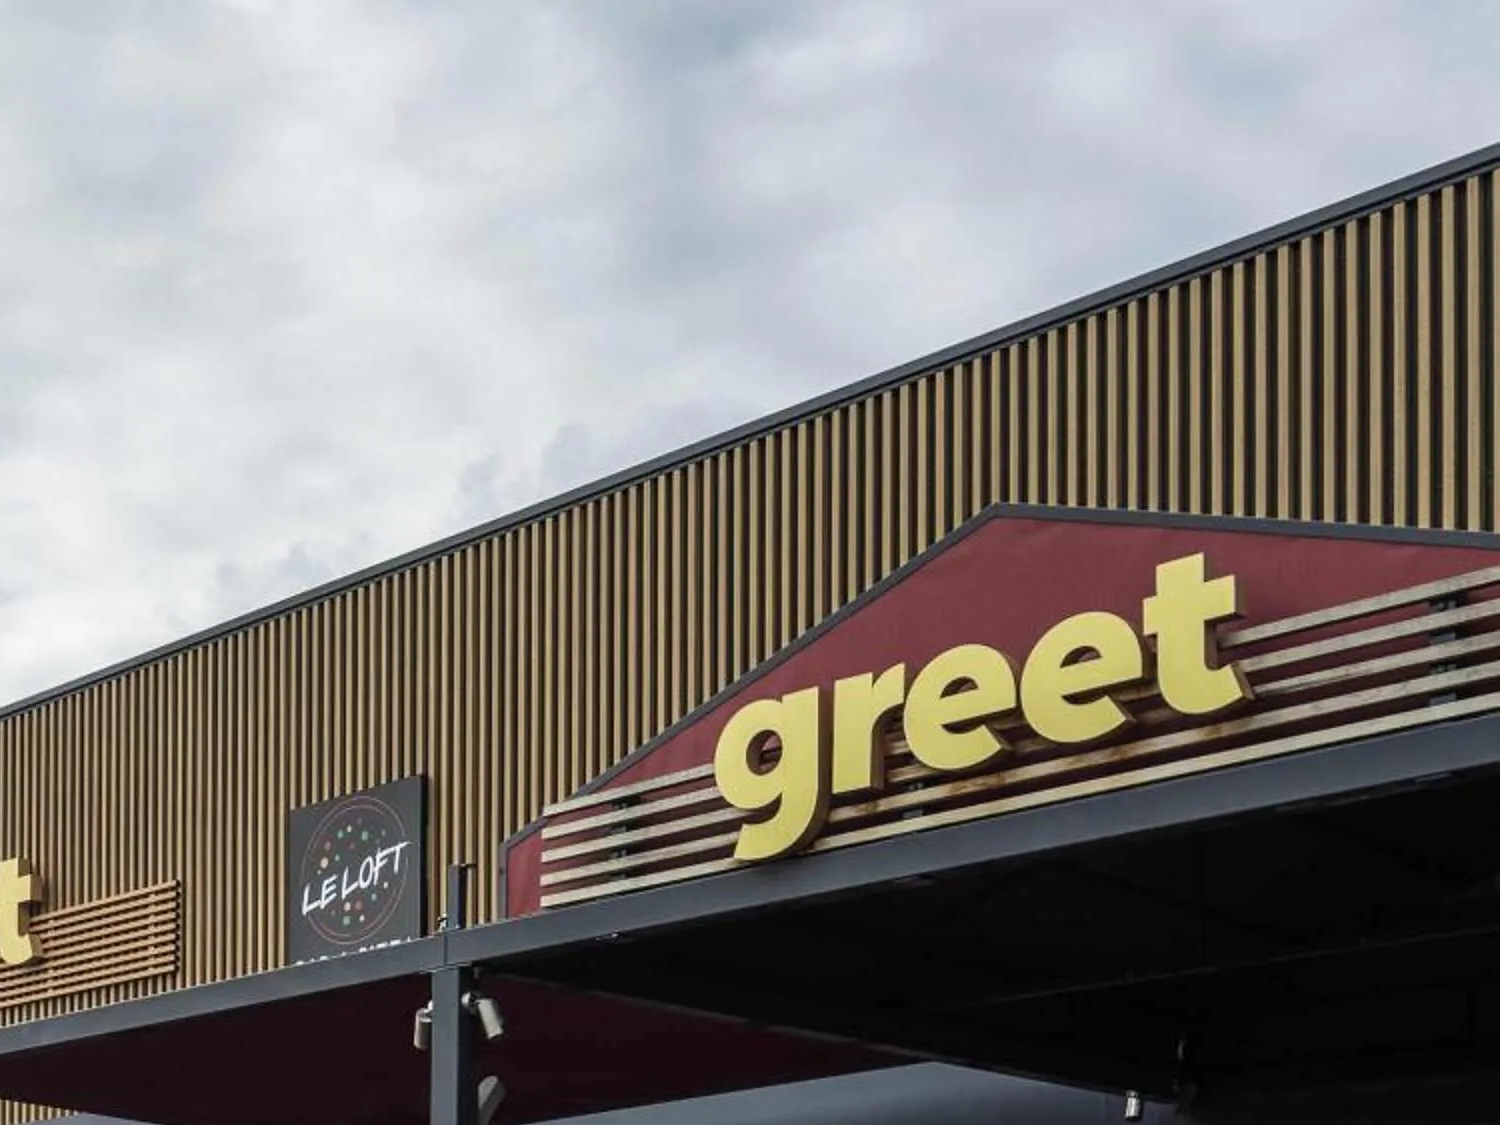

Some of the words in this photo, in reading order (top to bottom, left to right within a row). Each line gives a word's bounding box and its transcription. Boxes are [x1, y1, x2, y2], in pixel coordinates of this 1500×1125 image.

[714, 551, 1247, 862] greet
[300, 873, 338, 915] LE
[341, 840, 413, 900] LOFT
